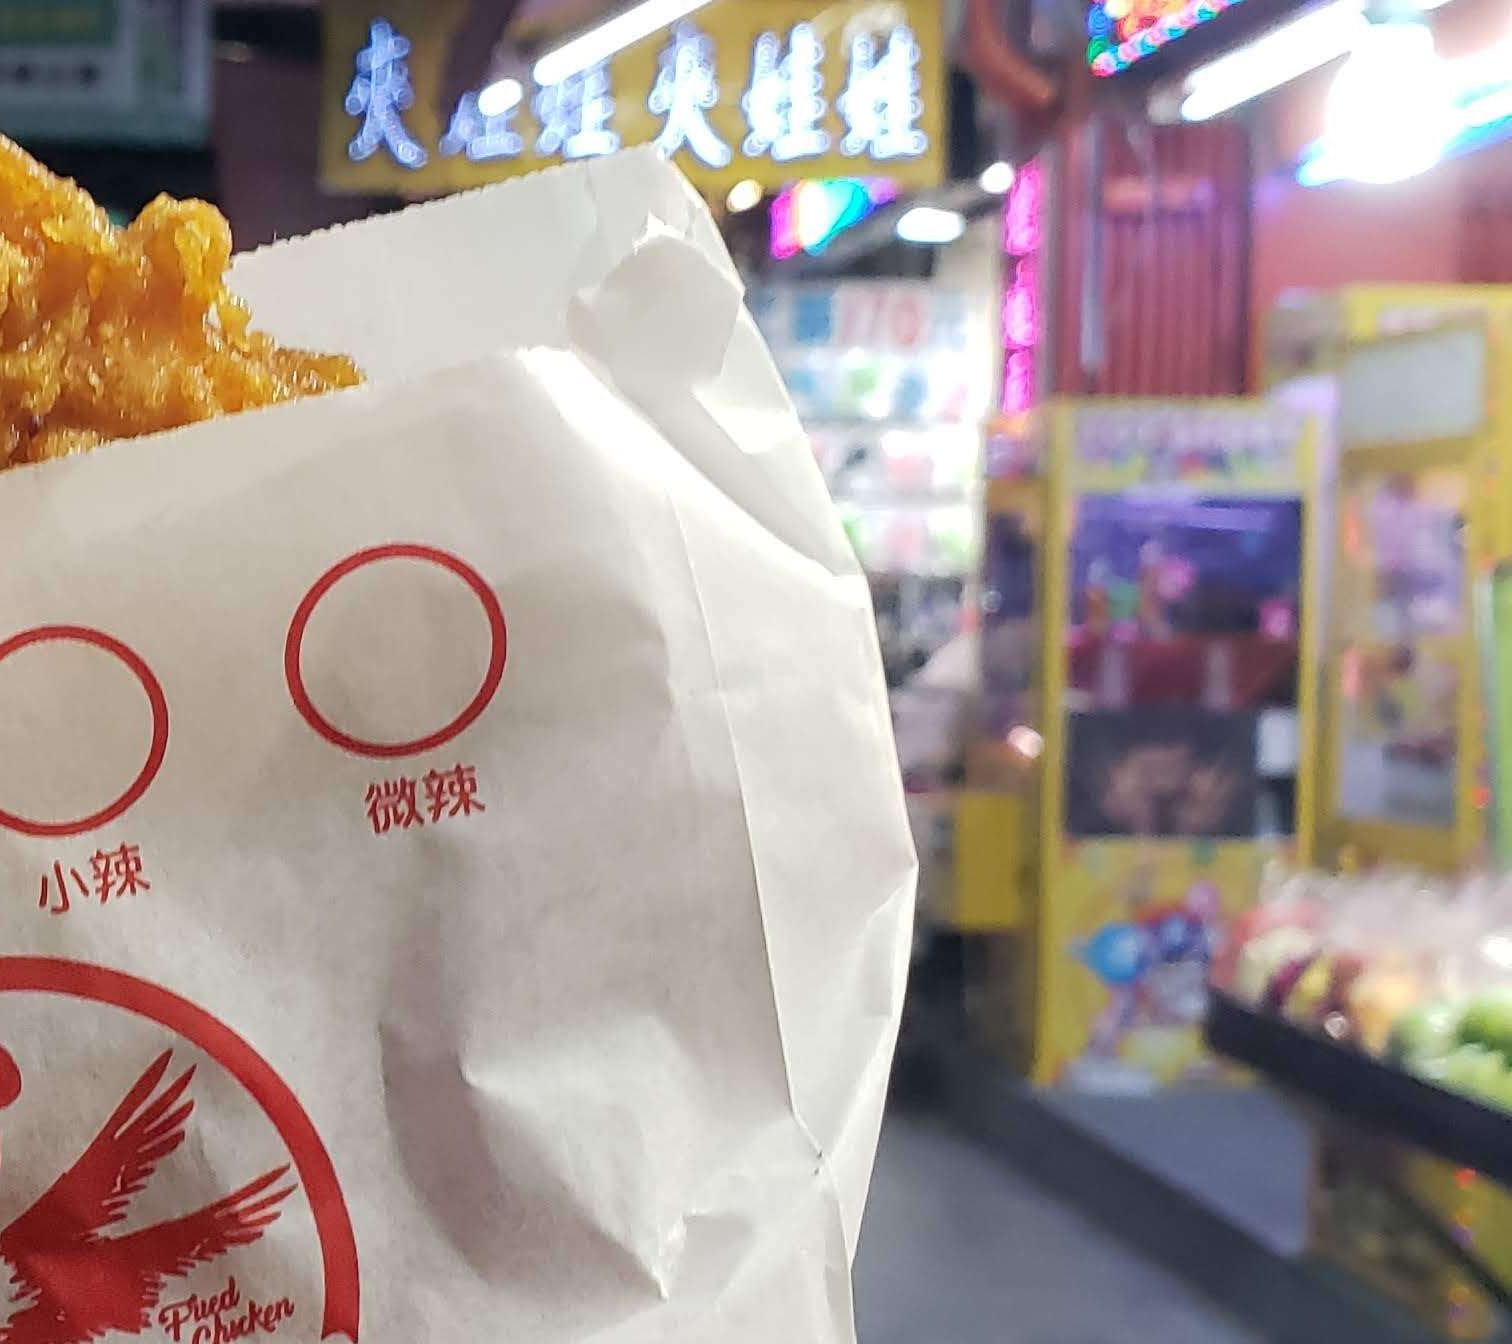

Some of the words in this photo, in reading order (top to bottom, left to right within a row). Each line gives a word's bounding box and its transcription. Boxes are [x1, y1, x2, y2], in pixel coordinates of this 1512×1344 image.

[365, 763, 486, 834] 微辣
[39, 841, 151, 914] 小辣
[158, 1275, 241, 1343] Fried
